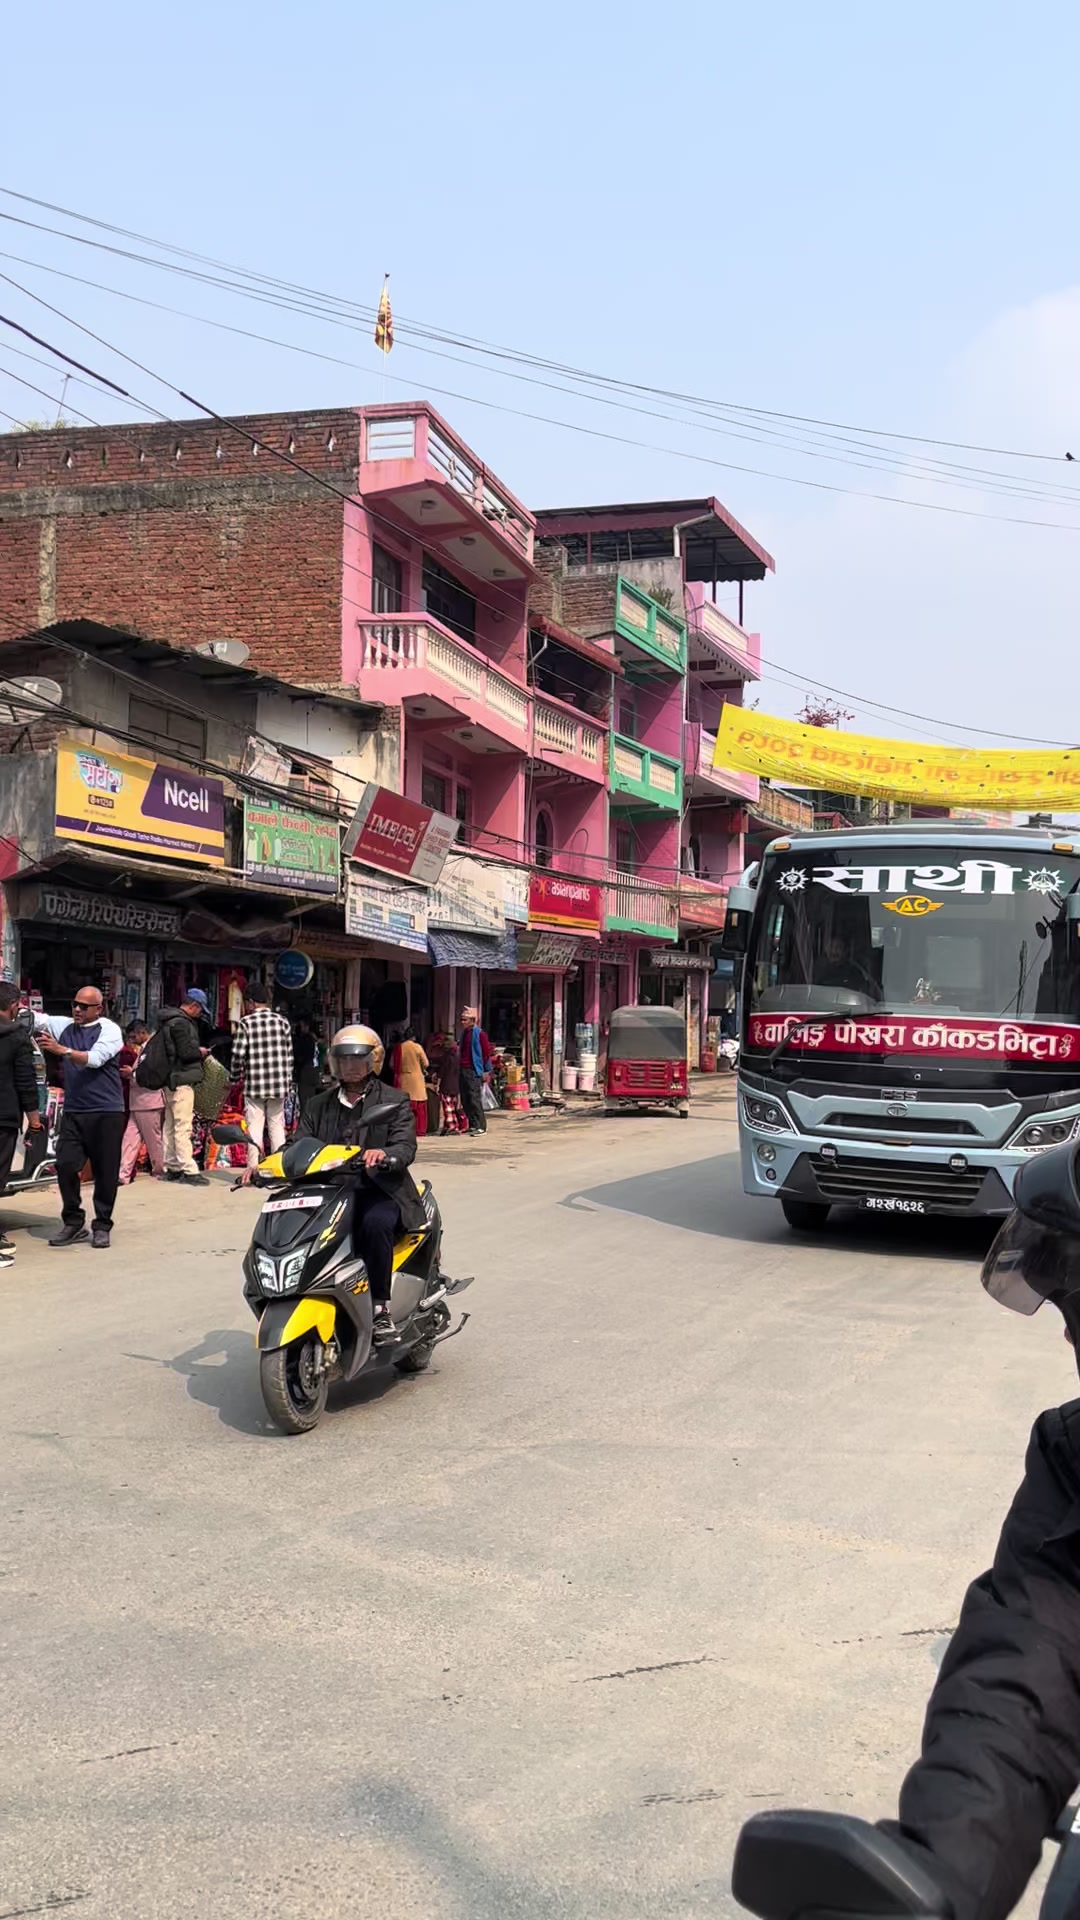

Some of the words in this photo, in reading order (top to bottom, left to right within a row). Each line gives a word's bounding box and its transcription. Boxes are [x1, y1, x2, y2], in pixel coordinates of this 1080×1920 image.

[164, 778, 209, 813] Ncell
[812, 860, 1023, 895] साथी
[899, 896, 927, 912] AC
[834, 1018, 907, 1046] पोखरा
